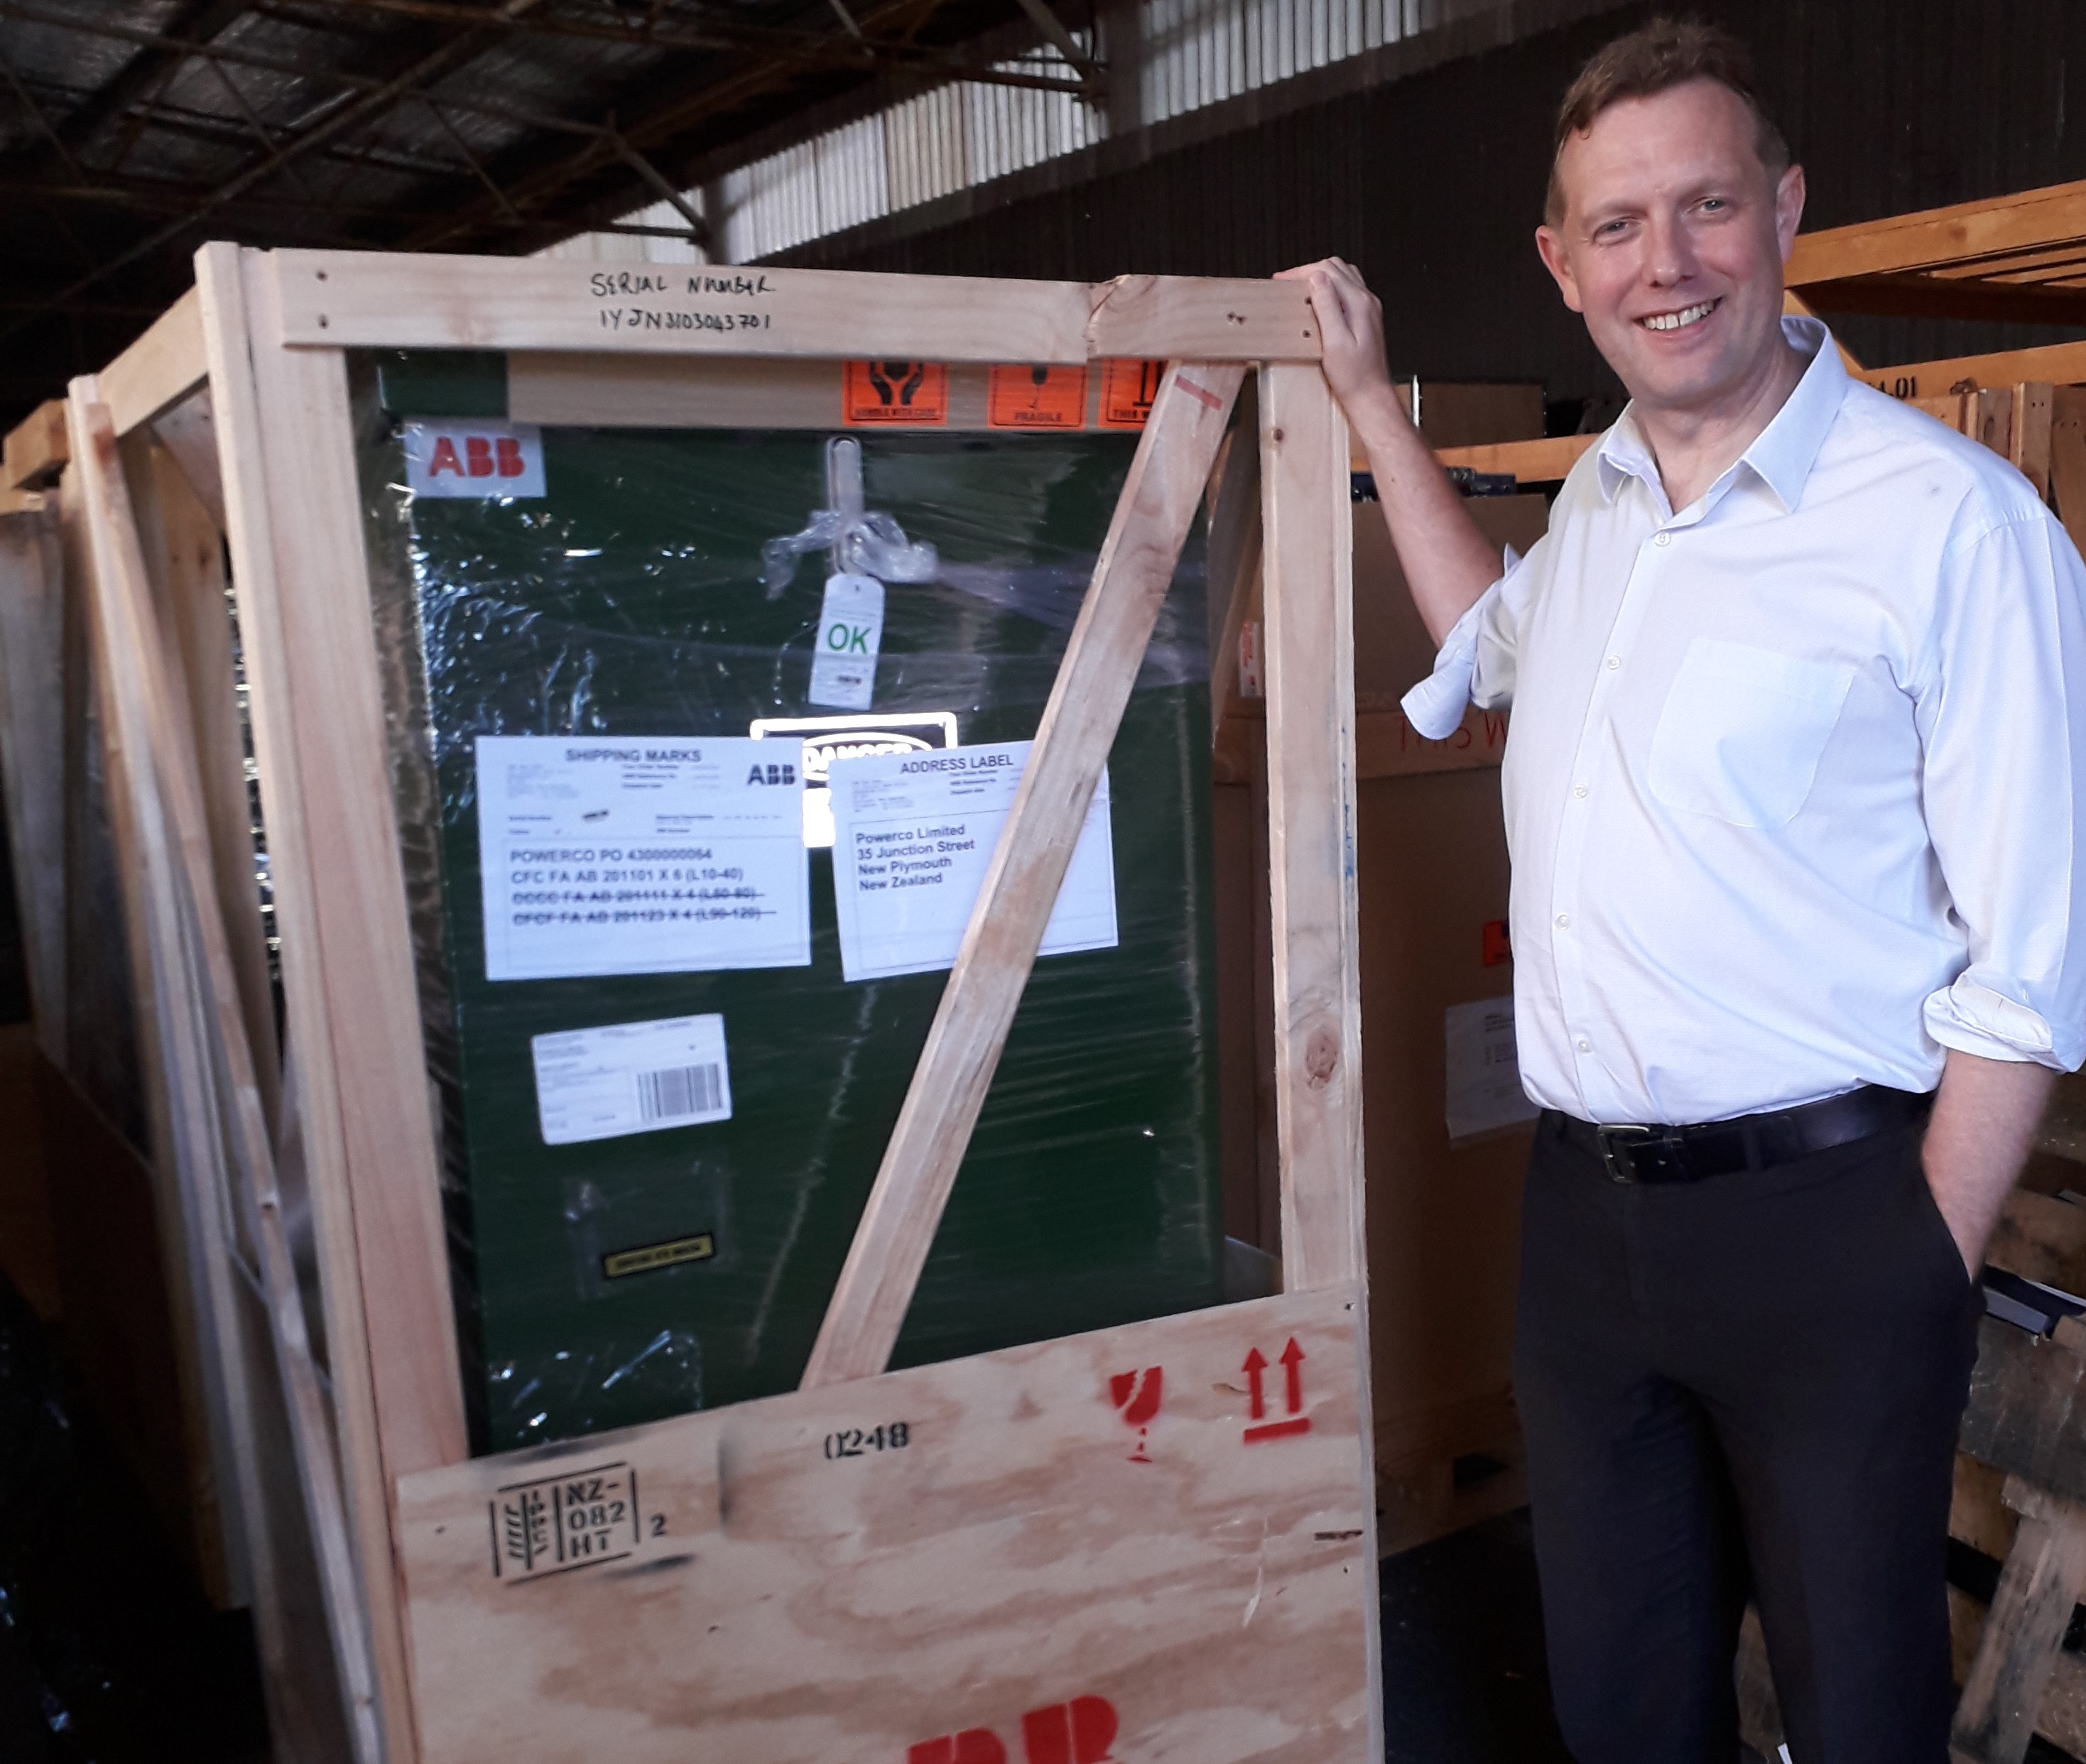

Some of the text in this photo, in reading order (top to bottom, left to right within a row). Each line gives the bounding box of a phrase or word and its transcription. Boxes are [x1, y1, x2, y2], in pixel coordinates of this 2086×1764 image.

[1014, 412, 1063, 423] FRAGILE
[429, 437, 526, 477] ABB
[828, 624, 871, 654] OK
[566, 749, 702, 762] SHIPPING MARKS
[900, 754, 1014, 774] ADDRESS LABEL
[747, 764, 796, 786] ABB
[856, 824, 966, 844] Powerco Limited
[510, 849, 595, 864] POWERCO
[599, 849, 623, 862] PO
[857, 839, 976, 860] 35 Junction Street
[858, 856, 952, 876] New Plymouth
[549, 870, 569, 883] FA
[576, 870, 598, 883] AB
[859, 872, 943, 891] New Zealand
[570, 1501, 668, 1538] 082 2
[571, 1528, 612, 1557] HT
